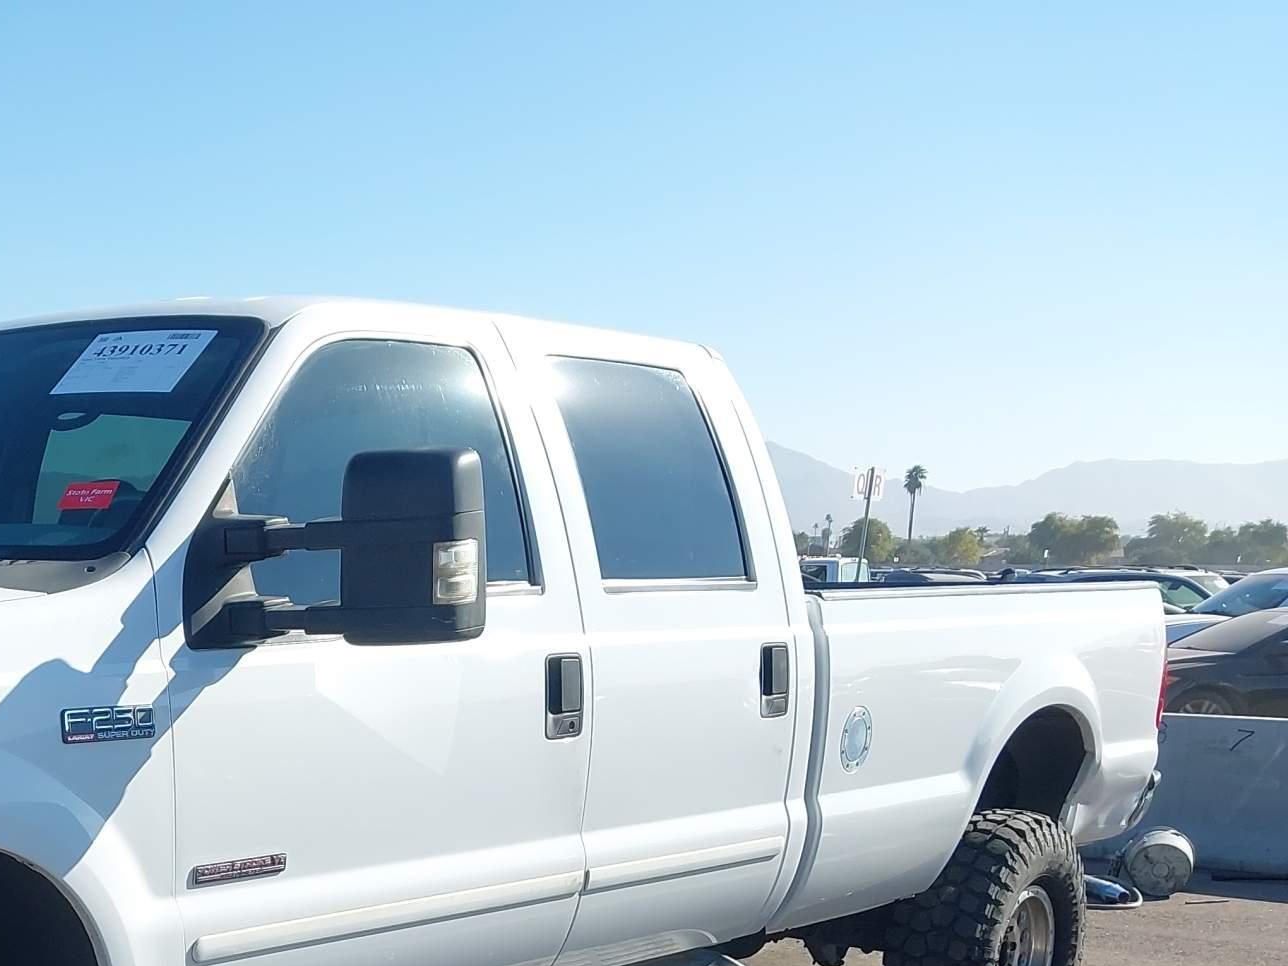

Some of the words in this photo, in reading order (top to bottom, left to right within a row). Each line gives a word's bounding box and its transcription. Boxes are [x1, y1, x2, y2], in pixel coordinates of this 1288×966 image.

[93, 343, 189, 357] 43910371
[873, 474, 882, 496] R
[98, 730, 129, 739] SUPER
[130, 728, 154, 737] DUTY
